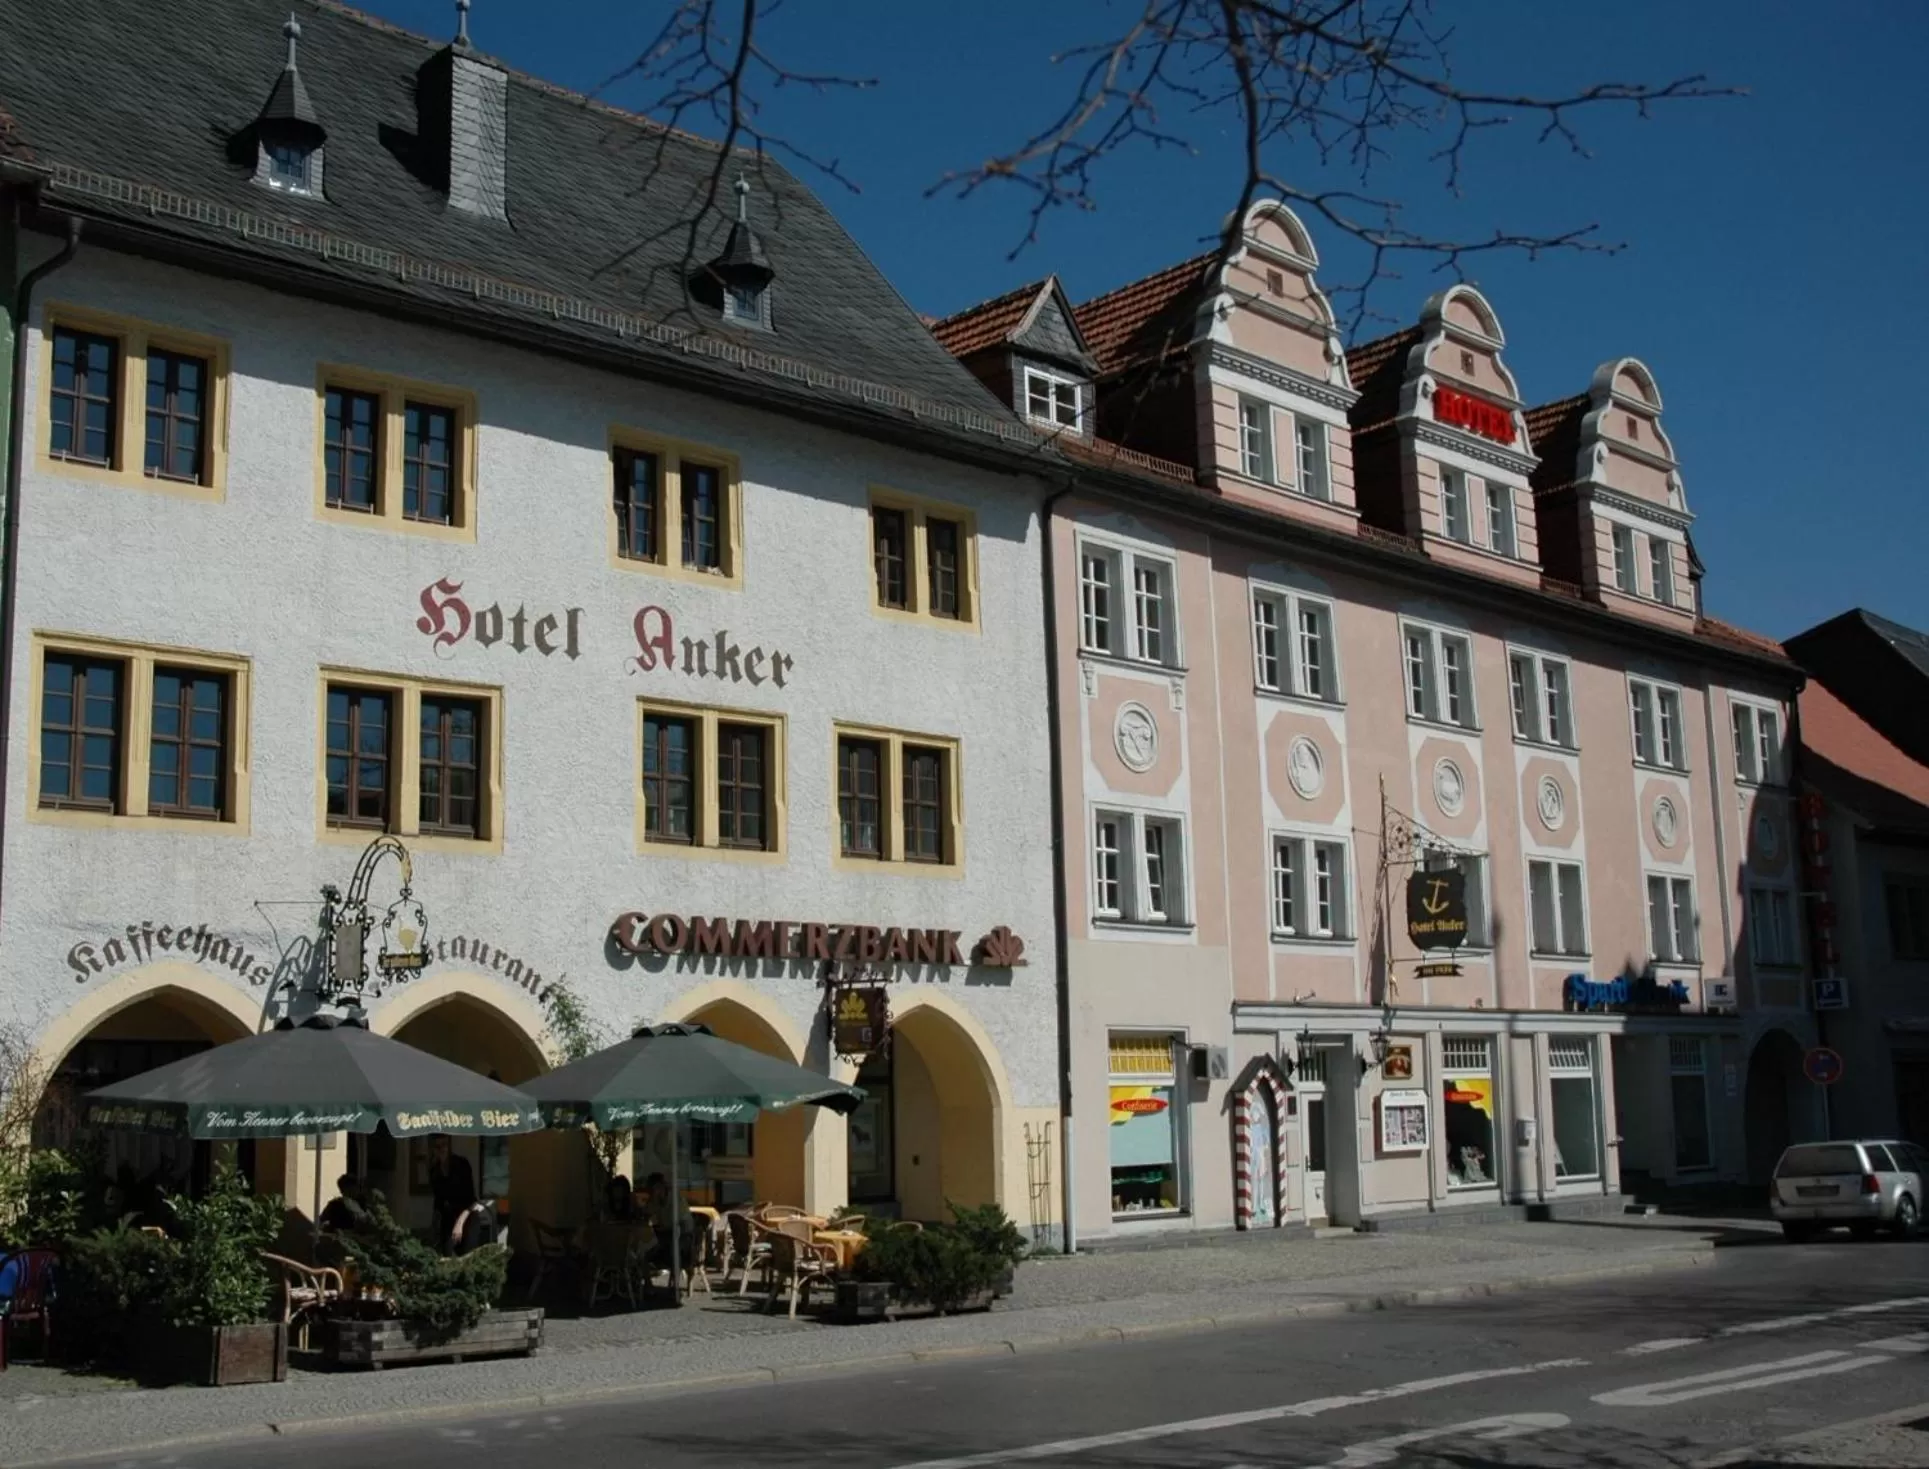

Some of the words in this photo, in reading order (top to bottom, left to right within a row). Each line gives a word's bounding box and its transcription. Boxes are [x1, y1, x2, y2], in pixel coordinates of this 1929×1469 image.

[1434, 387, 1515, 444] HOTEL
[416, 577, 585, 663] Hotel
[625, 605, 794, 690] Anker
[67, 920, 274, 986] Kaffeehaus
[616, 911, 966, 965] COMMERZBANK
[480, 1109, 520, 1129] Bier
